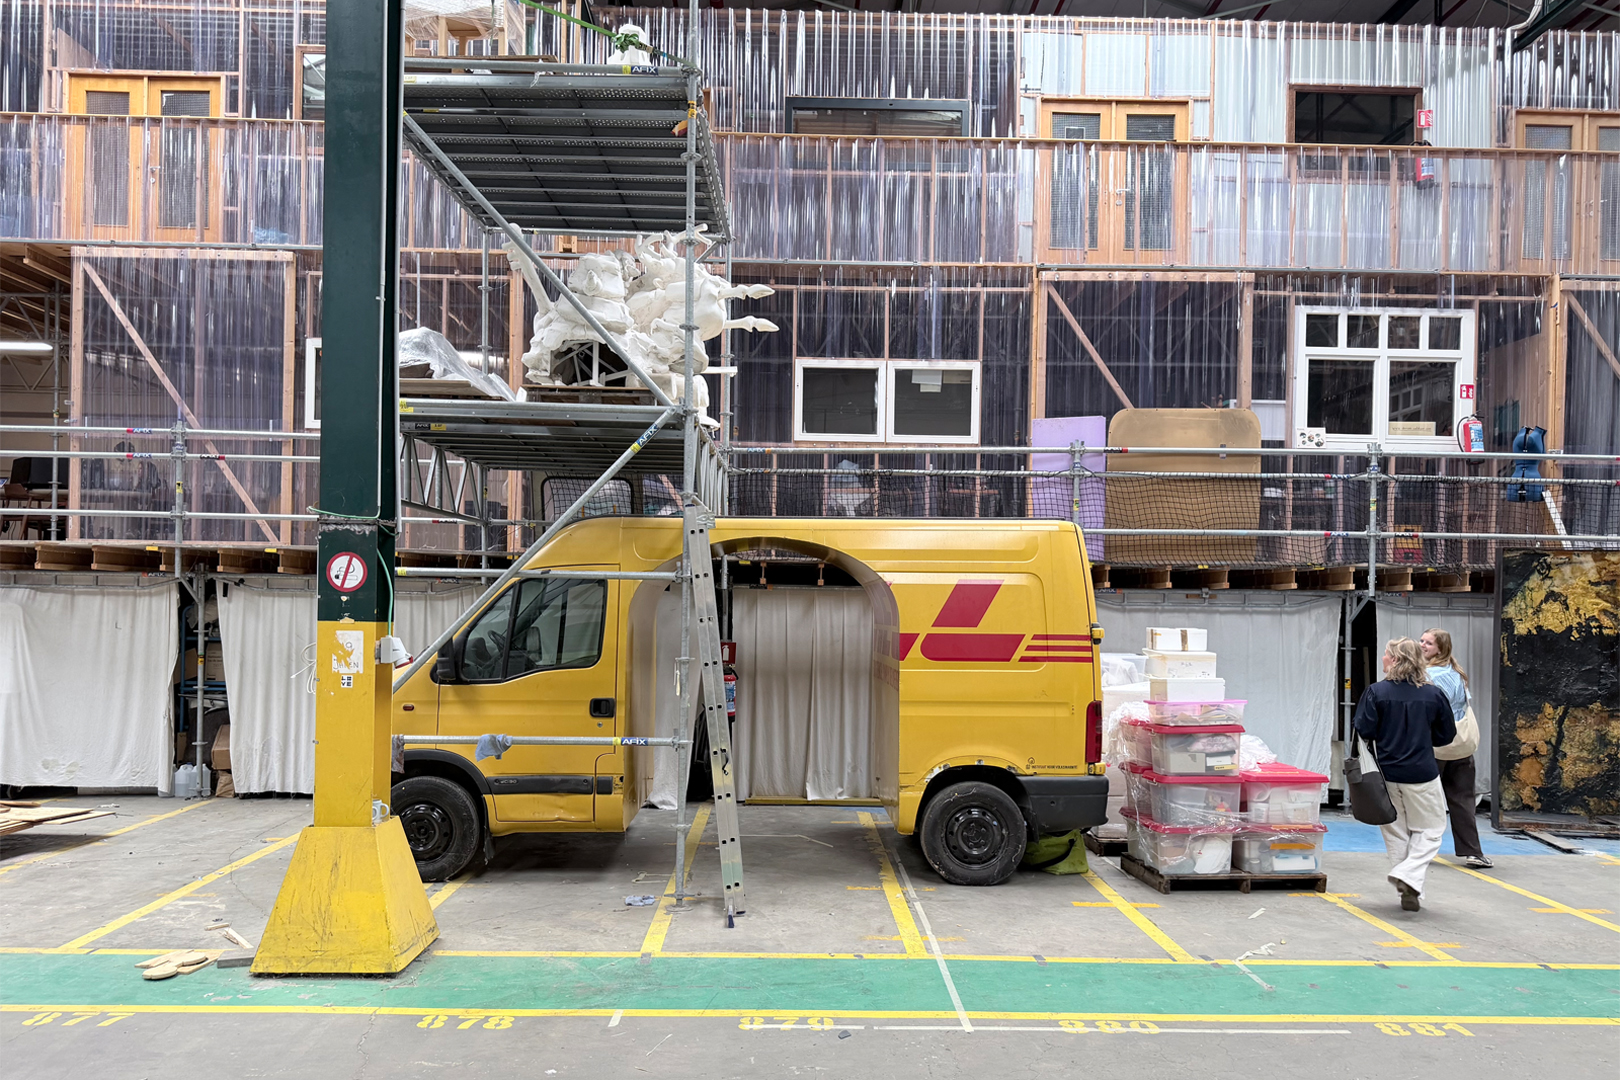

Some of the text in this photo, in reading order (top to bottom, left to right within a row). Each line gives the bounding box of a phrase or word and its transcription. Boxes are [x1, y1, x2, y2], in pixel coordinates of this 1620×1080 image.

[639, 426, 658, 446] AFIX
[21, 1012, 136, 1027] 877
[416, 1015, 515, 1030] 878
[738, 1016, 834, 1031] 879
[1058, 1020, 1160, 1034] 880
[1373, 1022, 1476, 1037] 881
